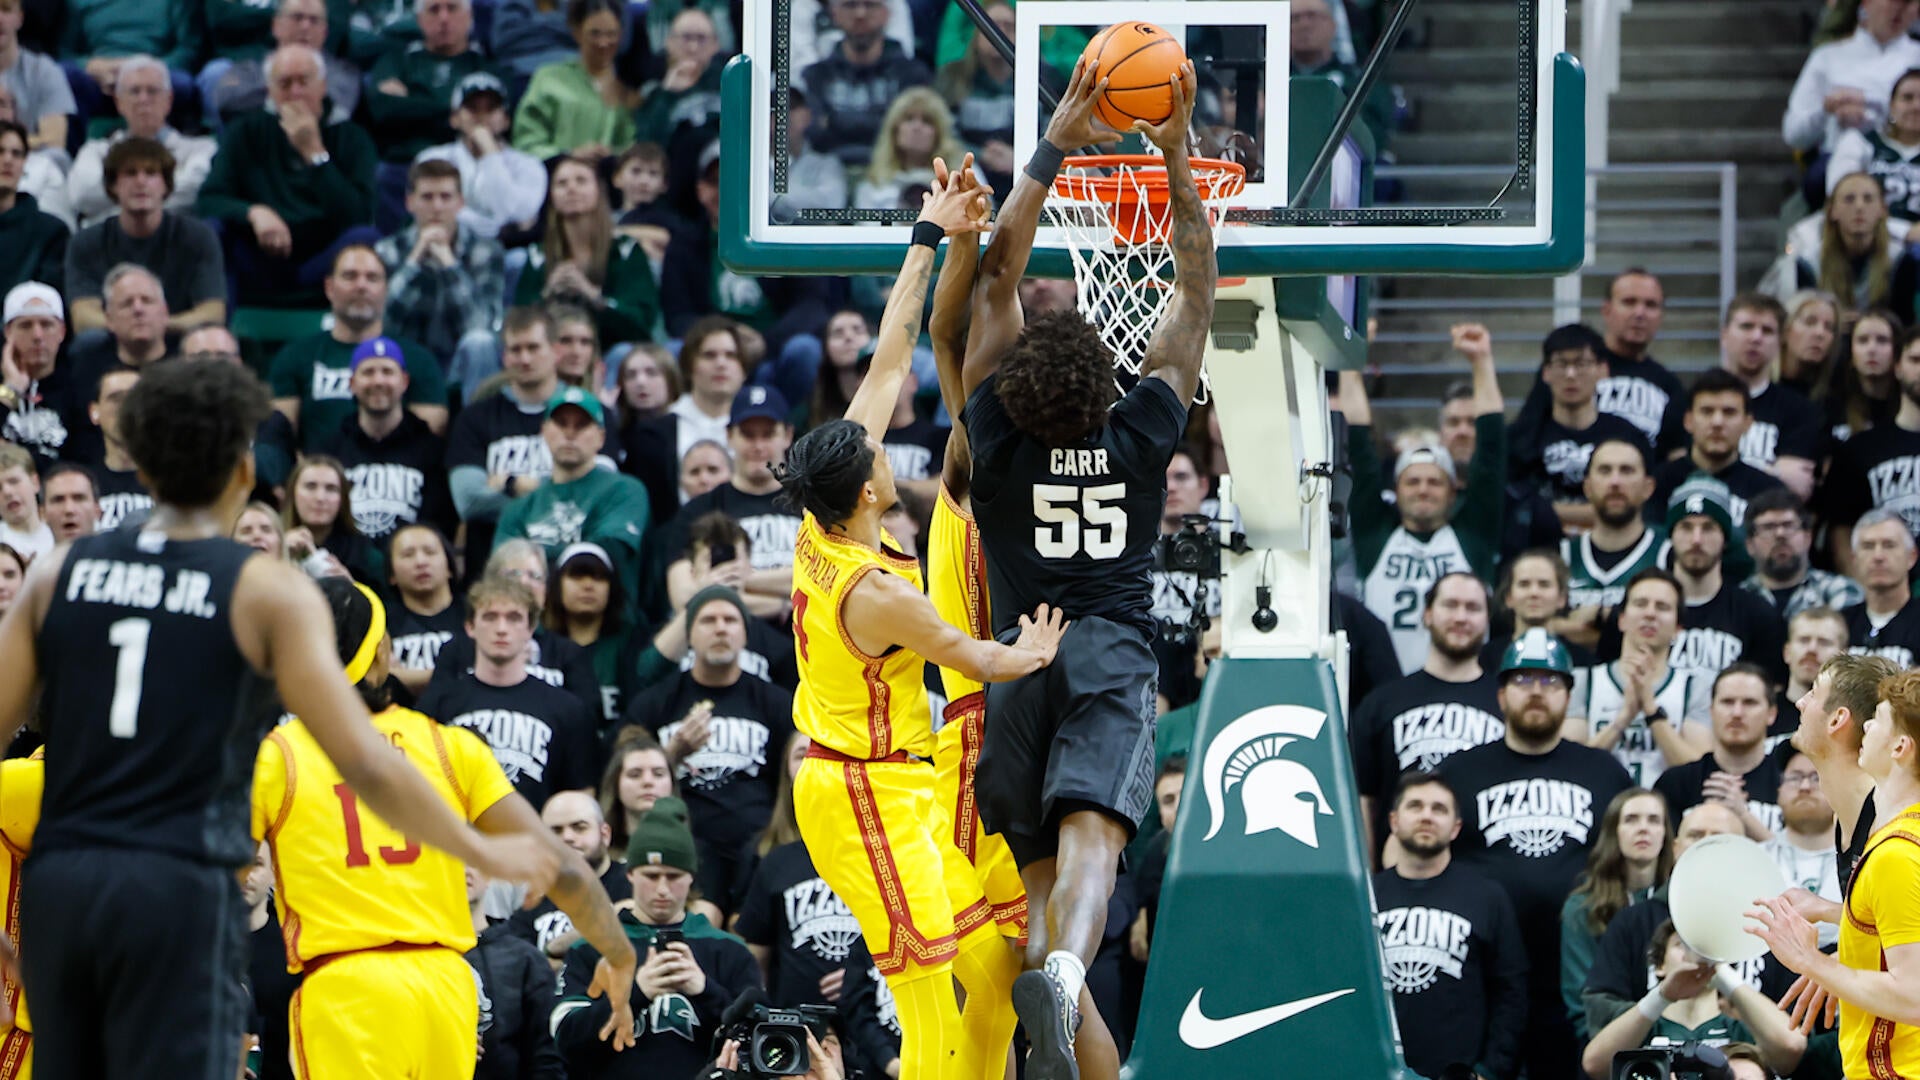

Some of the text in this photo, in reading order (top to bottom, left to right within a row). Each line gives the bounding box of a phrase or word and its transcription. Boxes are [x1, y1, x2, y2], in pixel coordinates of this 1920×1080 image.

[1050, 448, 1110, 477] CARR
[1032, 482, 1128, 560] 55
[66, 558, 217, 618] FEARS JR.
[108, 616, 151, 739] 1
[1476, 778, 1594, 831] IZZONE
